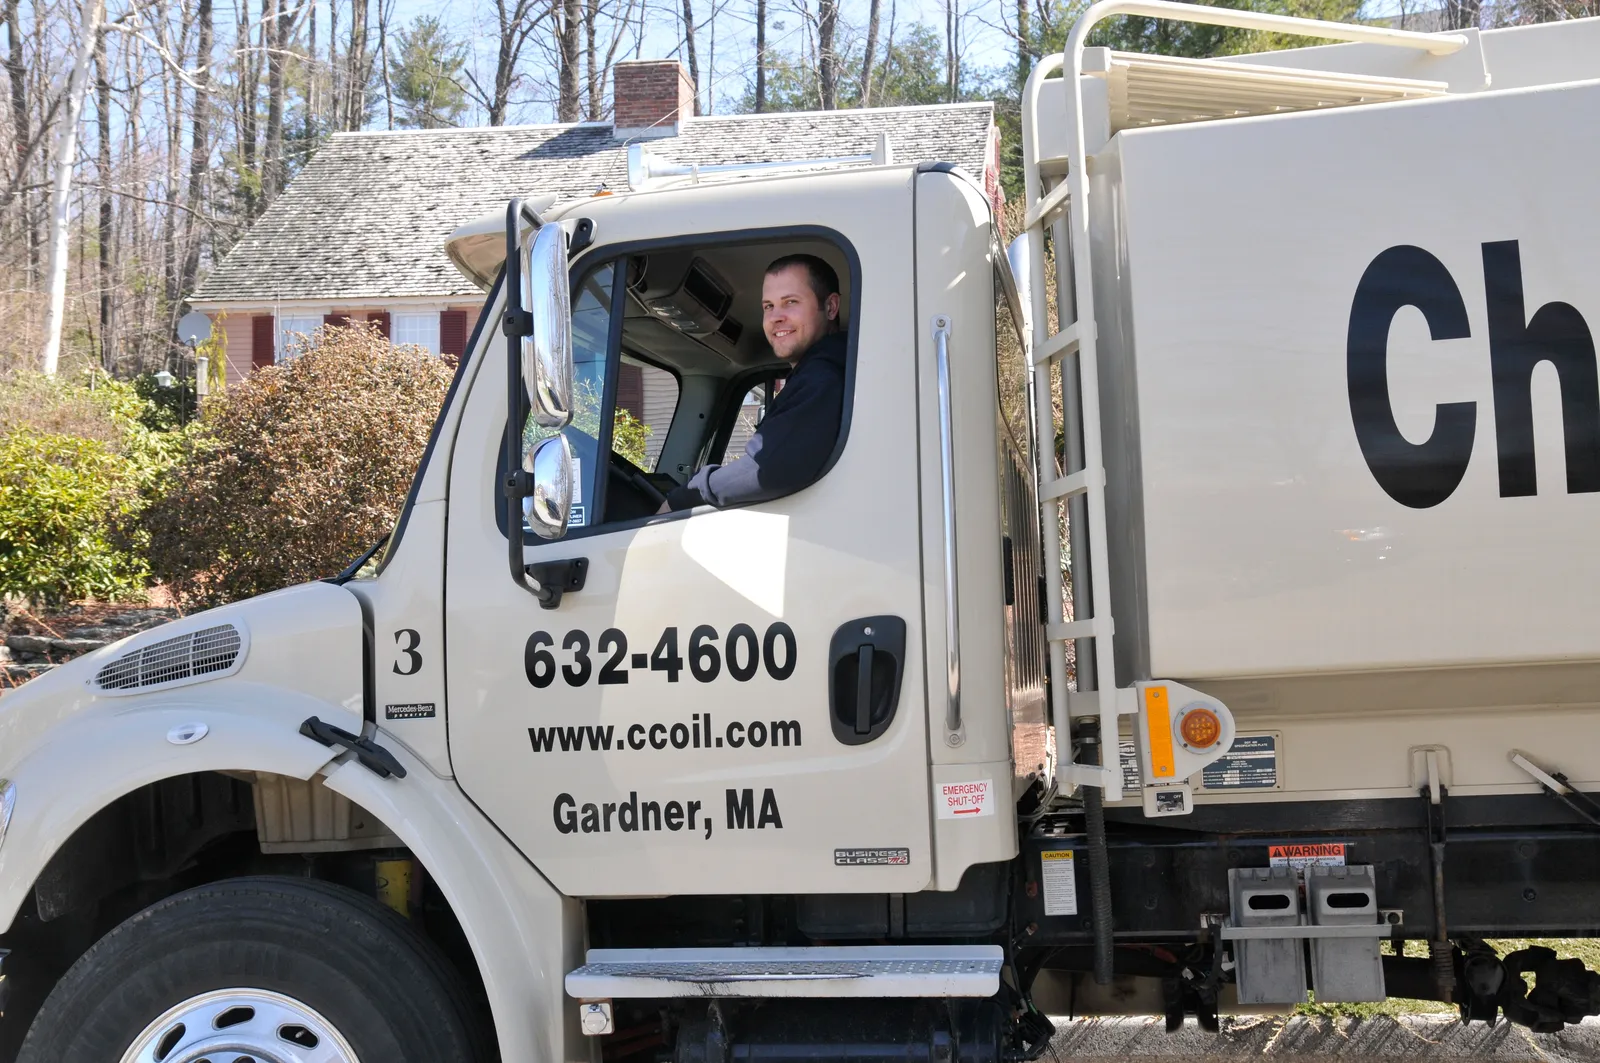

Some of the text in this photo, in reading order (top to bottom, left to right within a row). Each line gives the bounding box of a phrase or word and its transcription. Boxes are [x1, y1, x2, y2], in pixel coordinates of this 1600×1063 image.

[392, 628, 423, 675] 3
[524, 621, 798, 689] 632-4600
[387, 704, 434, 714] Mercedes-Benz
[528, 713, 802, 752] www.ccoil.com
[943, 782, 988, 795] EMERGENCY
[947, 794, 985, 806] SHUT-OFF
[553, 788, 784, 840] Gardner, MA
[1283, 845, 1341, 857] WARNING
